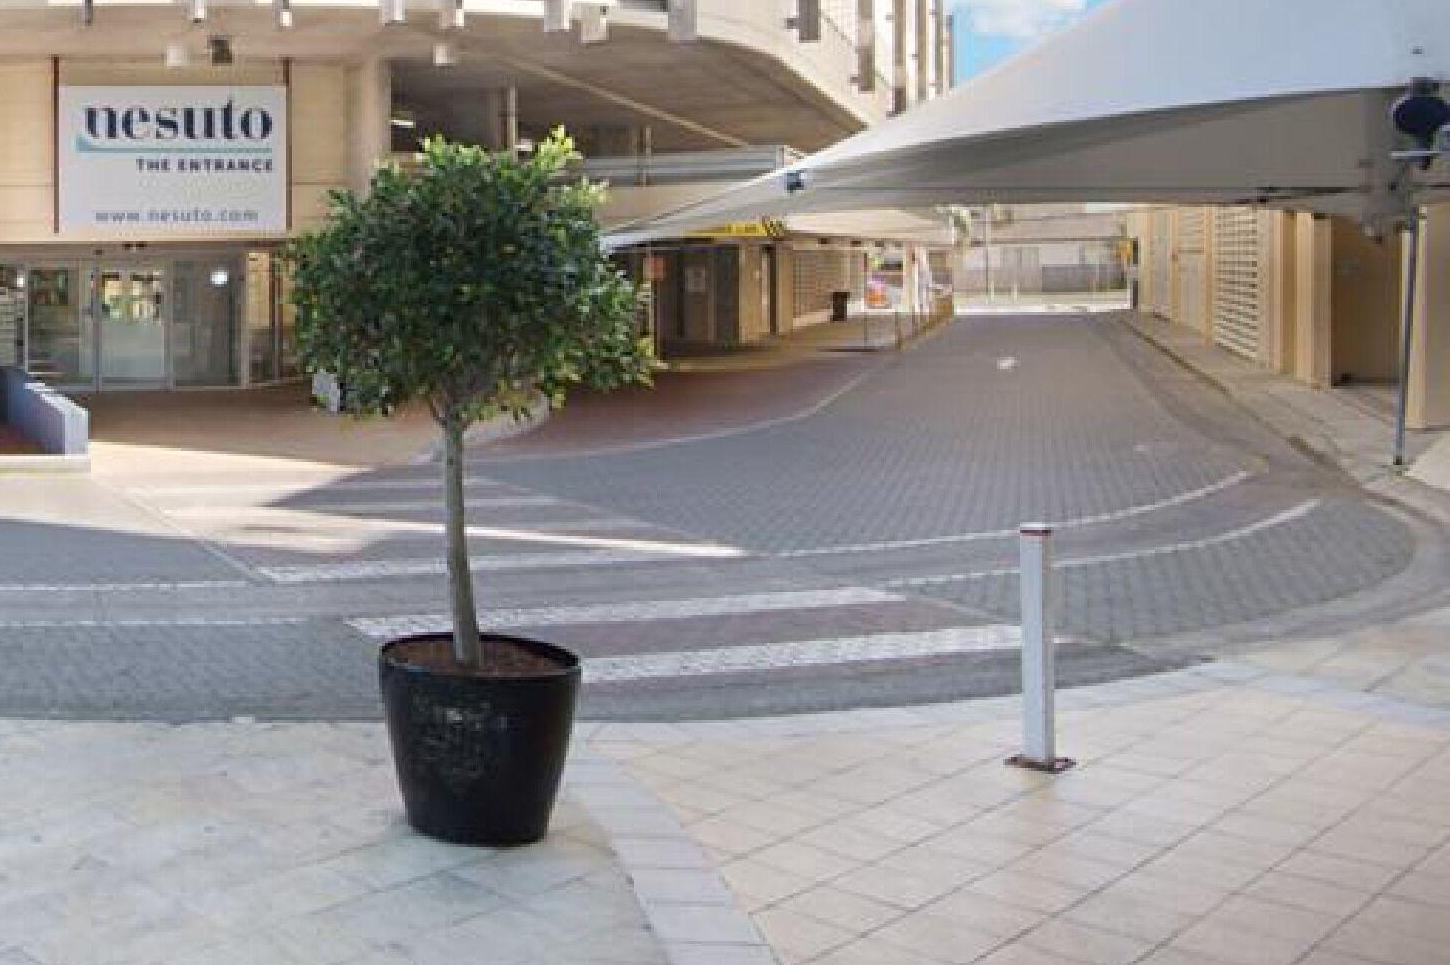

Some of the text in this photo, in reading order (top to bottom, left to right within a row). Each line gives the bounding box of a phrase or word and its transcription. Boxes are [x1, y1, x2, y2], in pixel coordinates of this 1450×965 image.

[84, 97, 273, 140] nesuto
[136, 158, 273, 173] THE ENTRANCE
[95, 208, 259, 223] www.nesuto.com
